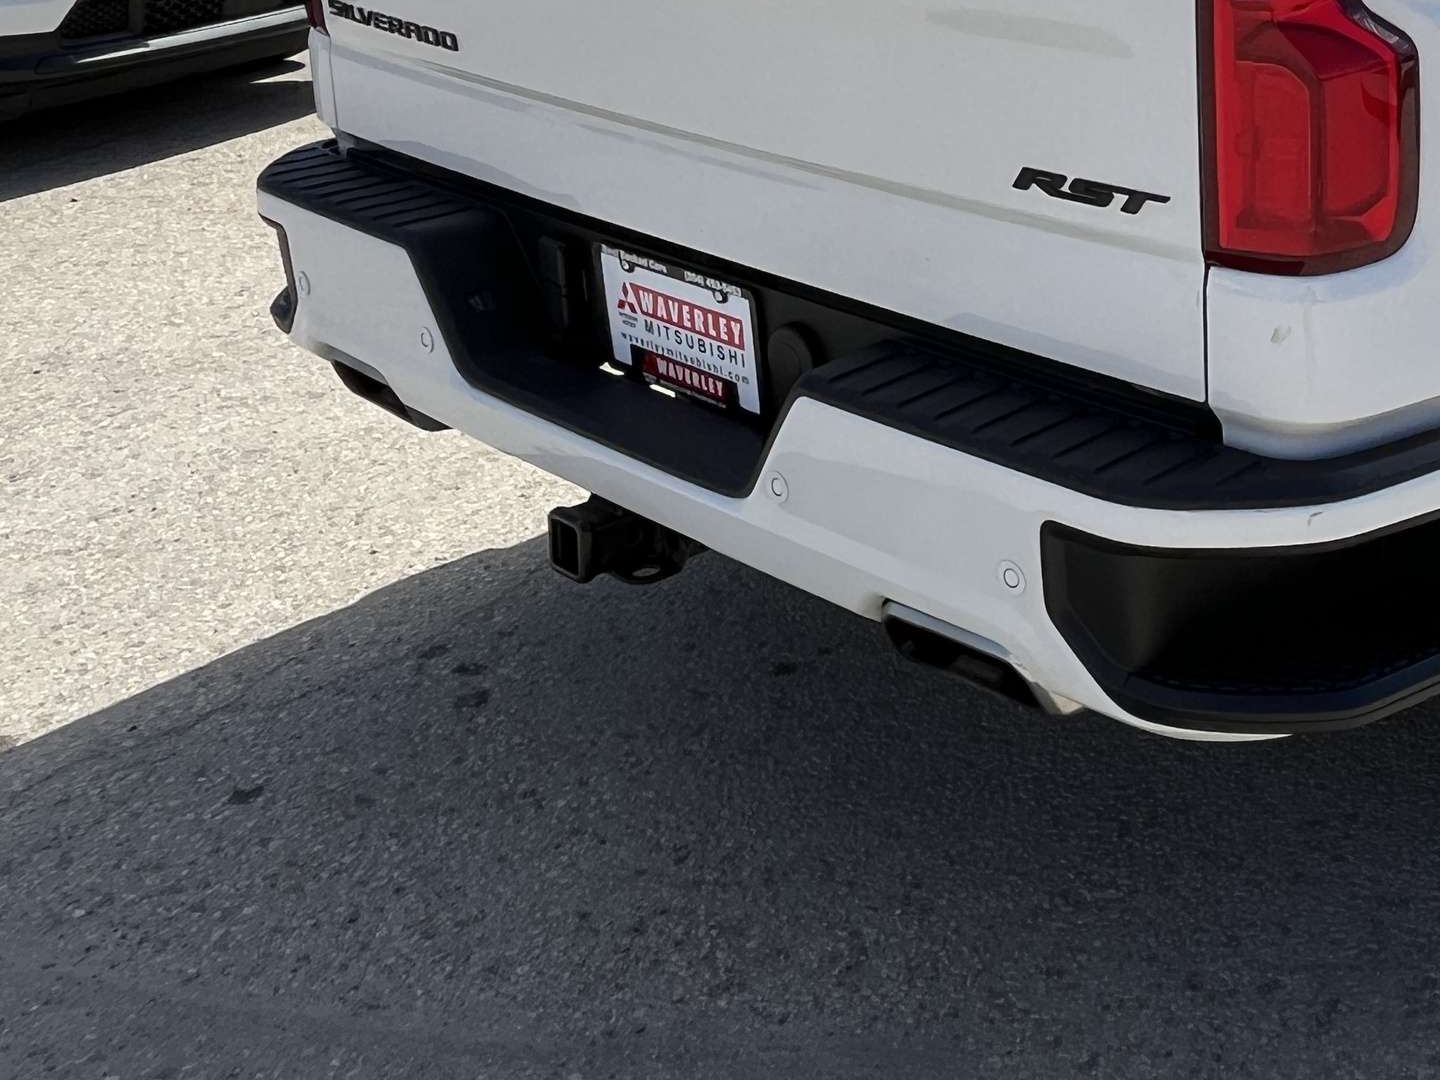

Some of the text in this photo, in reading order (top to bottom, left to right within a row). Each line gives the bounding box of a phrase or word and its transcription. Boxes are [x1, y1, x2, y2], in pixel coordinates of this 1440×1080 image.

[1012, 166, 1171, 215] RST
[637, 288, 742, 346] WAVERLEY
[643, 319, 746, 368] MITSUBISHI
[655, 357, 723, 397] WAVERLEY
